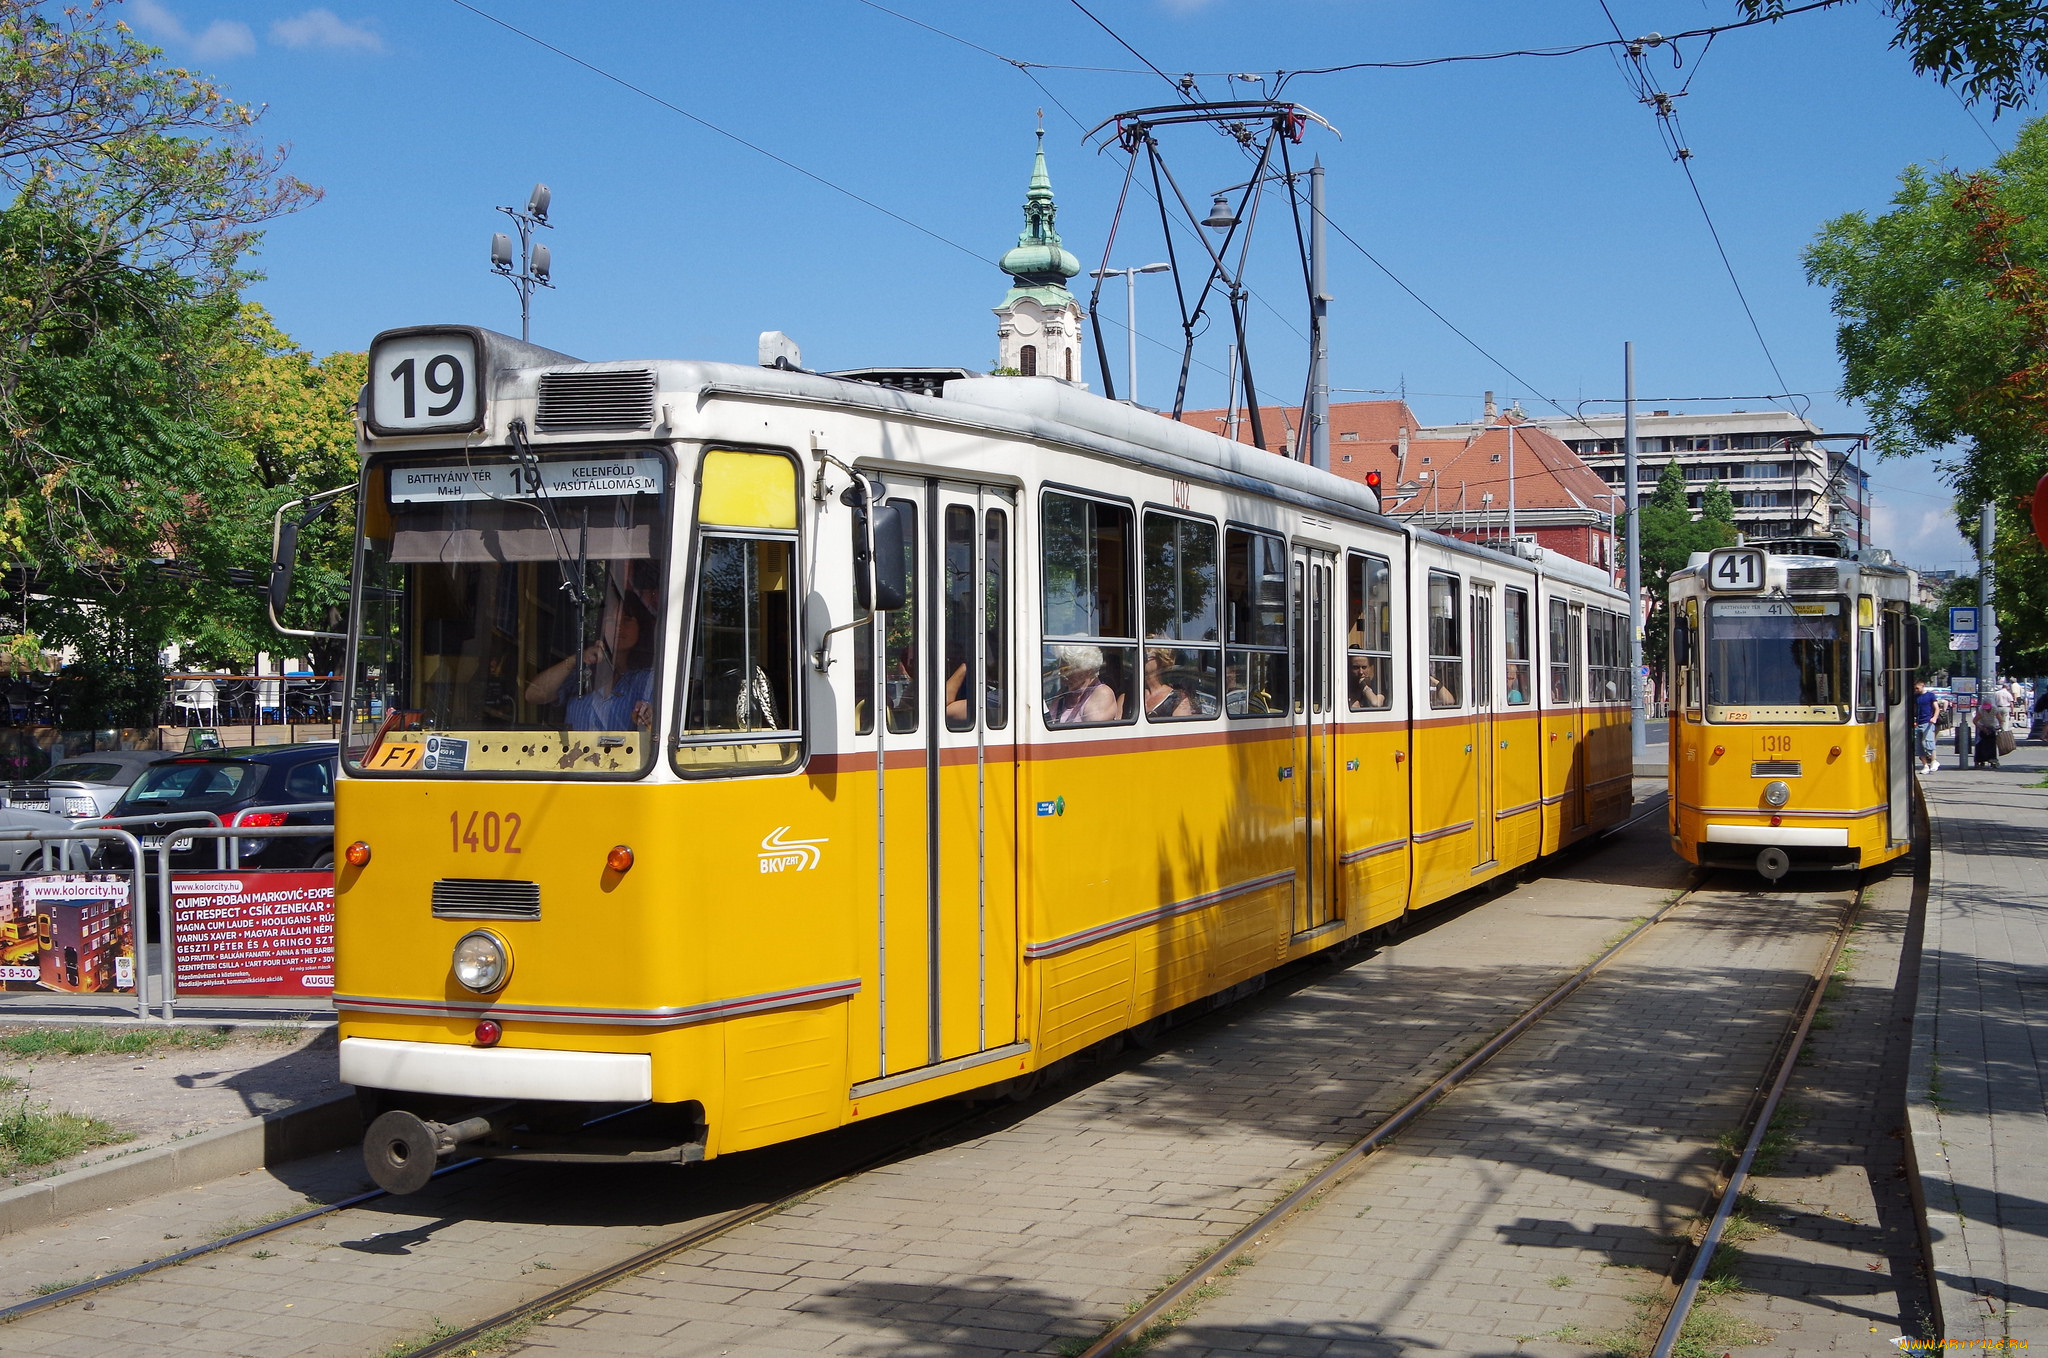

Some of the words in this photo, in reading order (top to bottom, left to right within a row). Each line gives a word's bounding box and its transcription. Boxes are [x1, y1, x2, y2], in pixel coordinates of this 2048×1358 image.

[391, 354, 464, 418] 19
[407, 471, 469, 484] BATTHYÁNY
[472, 469, 491, 481] TÉR
[572, 464, 635, 478] KELENFÖLD
[509, 467, 540, 494] 19
[553, 477, 641, 491] VASÚTÁLLOMÁS
[645, 479, 655, 488] M
[438, 486, 461, 495] M+H
[1172, 478, 1190, 509] 1402
[1718, 554, 1754, 583] 41
[1768, 604, 1782, 615] 41
[1729, 712, 1748, 720] F23
[1761, 735, 1791, 752] 1318
[380, 747, 416, 767] F1
[450, 810, 522, 853] 1402
[760, 857, 785, 873] BKV
[785, 856, 799, 866] ZRT
[34, 885, 124, 897] www.kolorcity.hu
[174, 882, 239, 891] www.kolorcity.hu
[175, 896, 212, 908] QUIMBY
[216, 893, 250, 905] BOBAN
[252, 887, 303, 903] MARKOVIĆ
[308, 887, 334, 899] EXPE
[176, 911, 194, 921] LGT
[197, 908, 240, 920] RESPECT
[248, 904, 273, 916] CSÍK
[274, 901, 324, 915] ZENEKAR
[176, 923, 206, 932] MAGNA
[207, 921, 225, 930] CUM
[227, 919, 254, 929] LAUDE
[261, 915, 311, 926] HOOLIGANS
[177, 933, 209, 942] VARNUS
[210, 931, 237, 941] XAVER
[244, 928, 278, 939] MAGYAR
[280, 925, 311, 936] ÁLLAMI
[313, 923, 333, 934] NÉPI
[177, 943, 210, 953] GESZTI
[214, 940, 244, 951] PÉTER
[247, 939, 259, 949] ÉS
[262, 940, 269, 948] A
[273, 937, 312, 947] GRINGO
[315, 935, 334, 945] SZT
[190, 954, 215, 962] FRUTTIK
[220, 951, 245, 960] BALKÁN
[245, 950, 271, 958] FANATIK
[8, 969, 36, 978] 8-30.
[177, 962, 217, 972] SZENTPÉTERI
[218, 961, 240, 969] CSILLA
[305, 977, 334, 985] AUGUS
